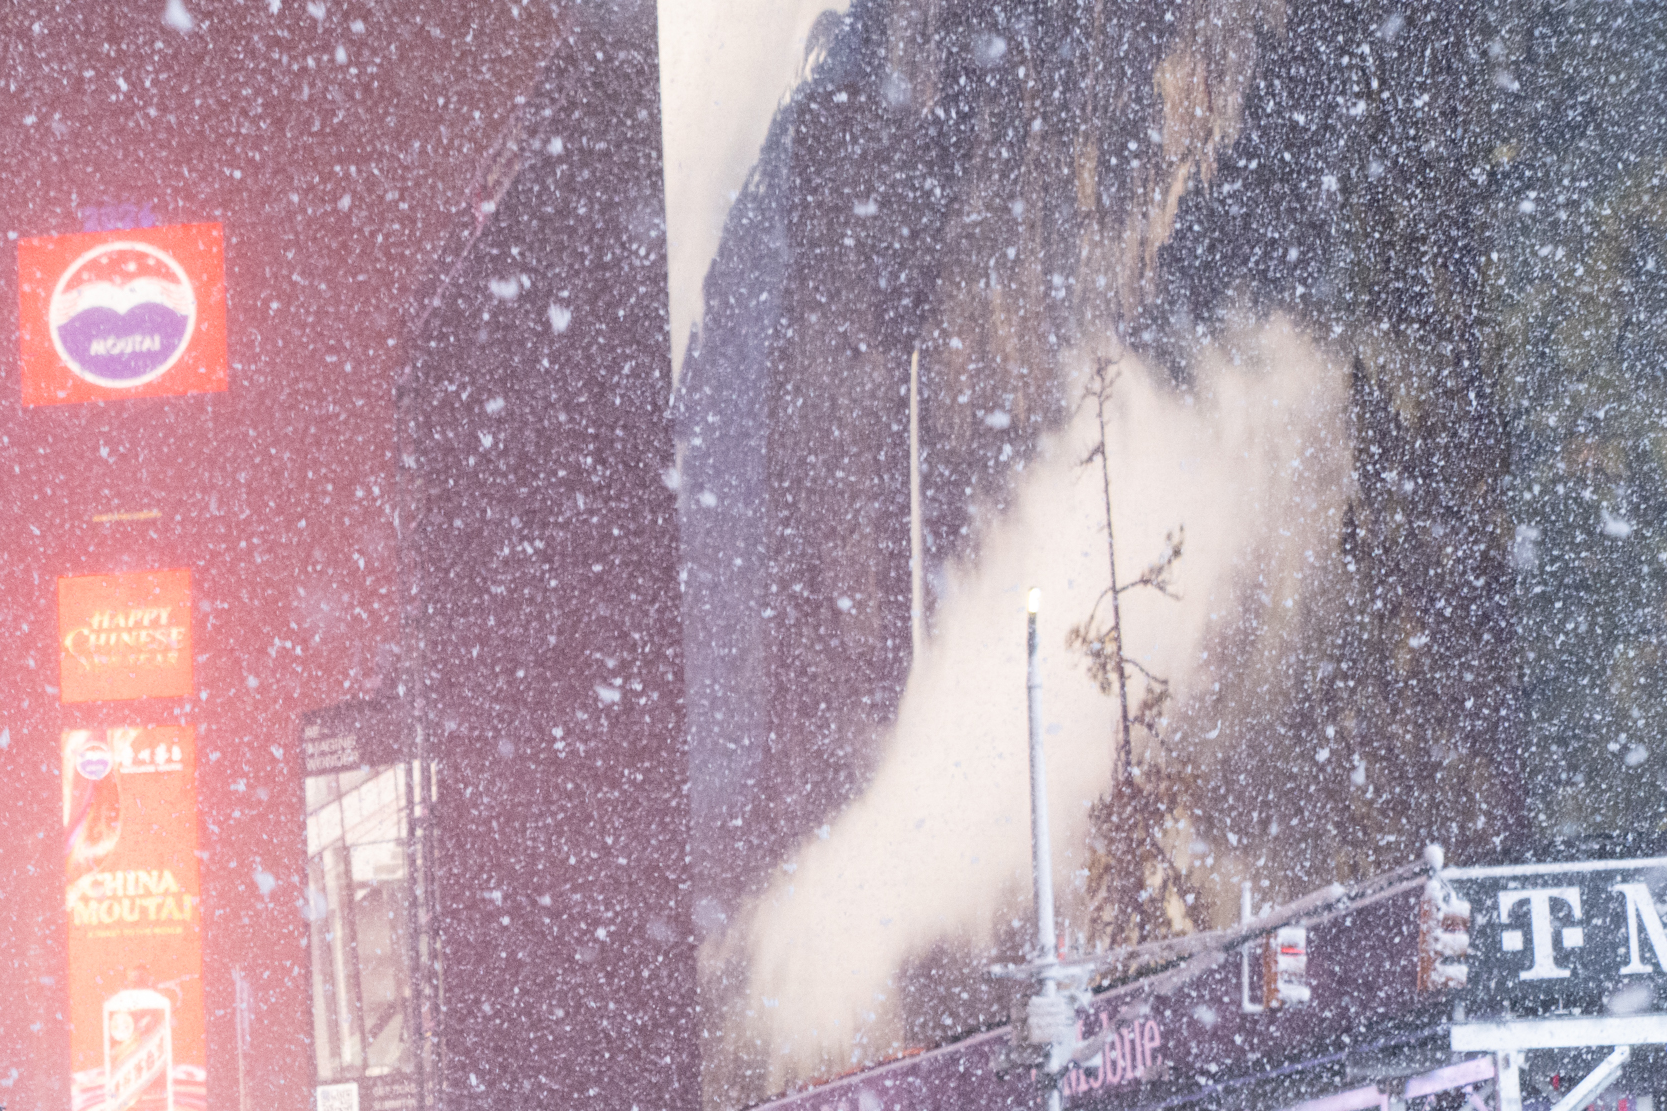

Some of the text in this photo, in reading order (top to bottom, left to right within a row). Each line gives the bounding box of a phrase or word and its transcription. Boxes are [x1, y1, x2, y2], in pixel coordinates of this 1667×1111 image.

[89, 334, 161, 356] MOUTAI
[90, 606, 172, 630] HAPPY
[64, 627, 186, 669] CHINESE
[78, 869, 181, 898] CHINA
[73, 893, 193, 927] MOUTAI
